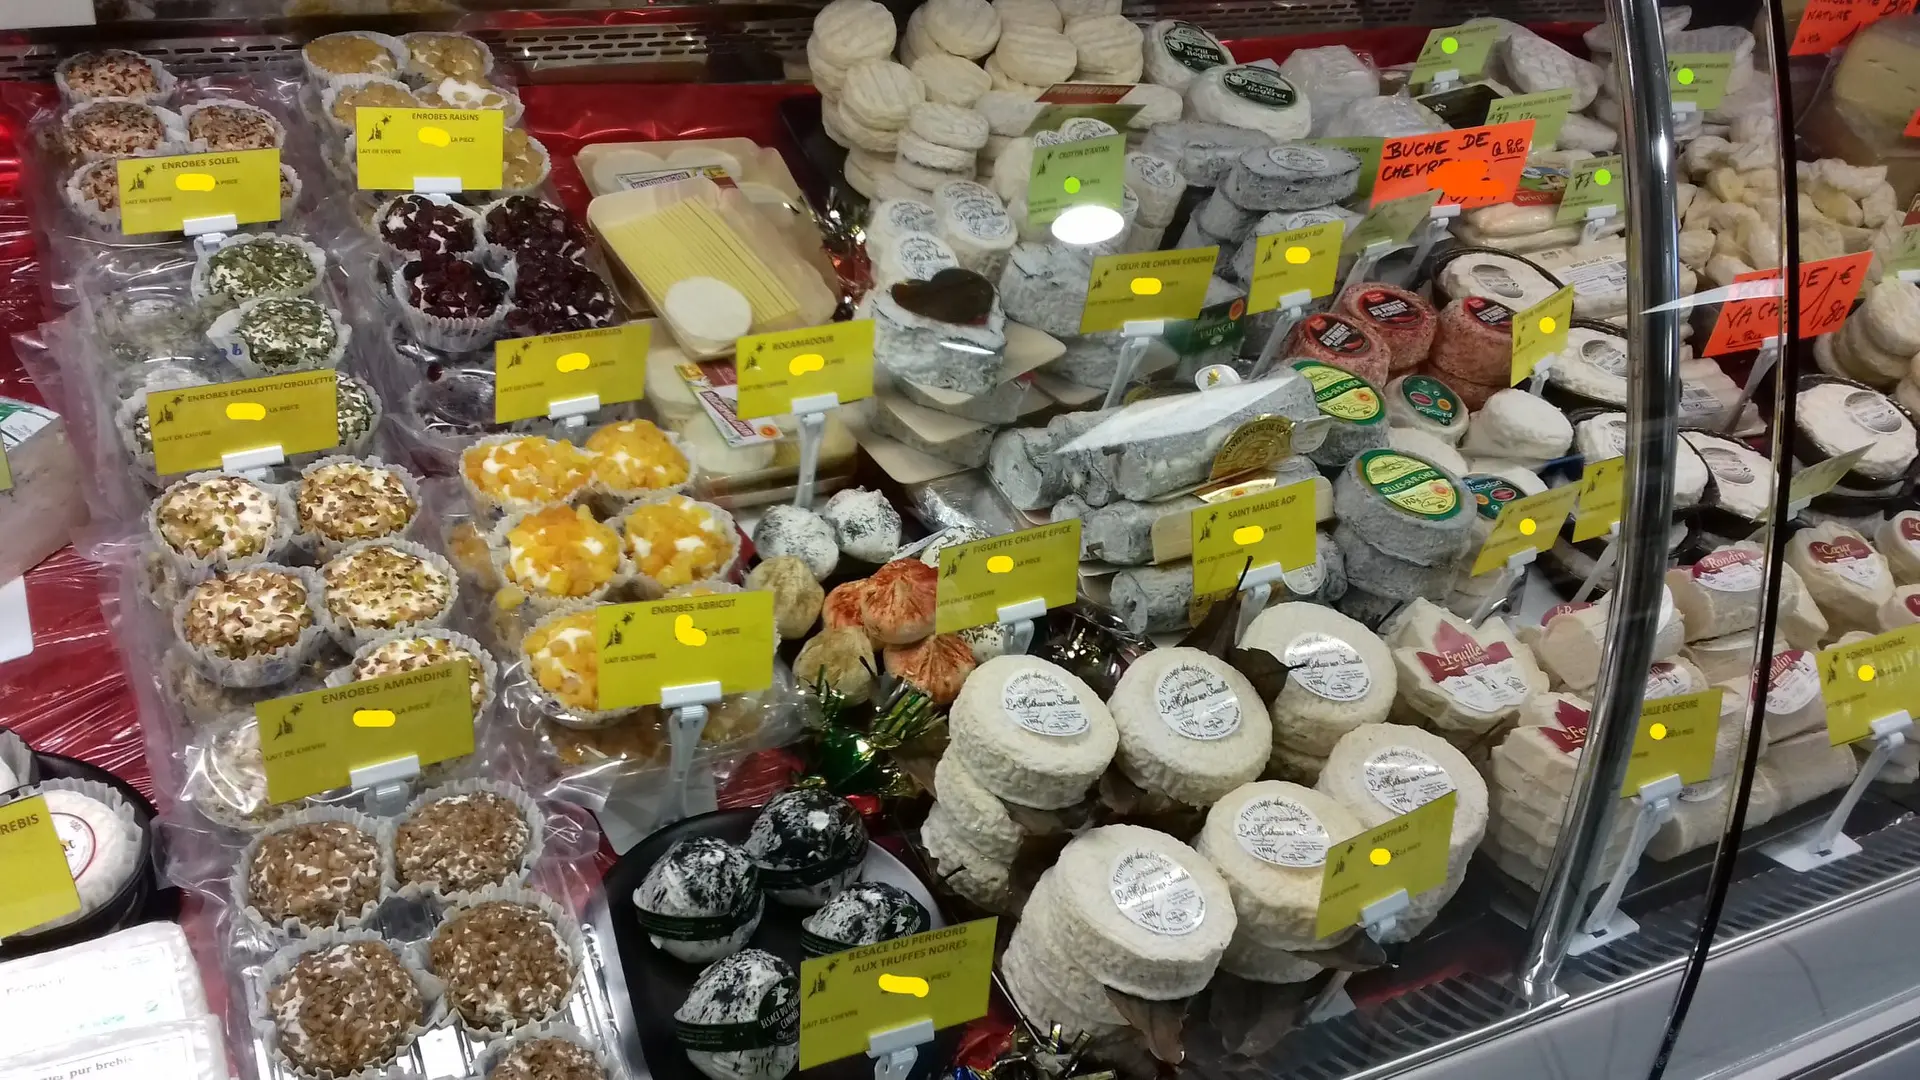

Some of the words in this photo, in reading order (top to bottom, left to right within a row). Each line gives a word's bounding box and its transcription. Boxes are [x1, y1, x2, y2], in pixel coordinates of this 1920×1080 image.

[412, 113, 448, 121] ENROBES
[1383, 140, 1450, 160] BUCHE
[1458, 132, 1491, 151] DE
[162, 159, 206, 170] ENROBES
[209, 156, 240, 166] SOLEIL
[188, 390, 228, 402] ENROBES
[1228, 508, 1250, 520] SAINT
[1251, 499, 1280, 513] MAURE
[1281, 495, 1297, 505] AOP
[1014, 531, 1048, 544] CHEVRE
[1708, 551, 1746, 569] Rondin
[651, 604, 694, 615] ENROBES
[697, 599, 736, 610] ABRICOT
[1444, 642, 1482, 664] Feuille
[321, 683, 380, 705] ENROBES
[383, 668, 453, 692] AMANDINE
[0, 814, 40, 835] REBIS
[848, 945, 889, 961] BESACE
[892, 939, 909, 950] DU
[912, 926, 968, 946] PERIGORD
[853, 962, 877, 975] AUX
[881, 951, 926, 971] TRUFFES
[929, 939, 968, 955] NOIRES
[70, 1065, 92, 1080] pur
